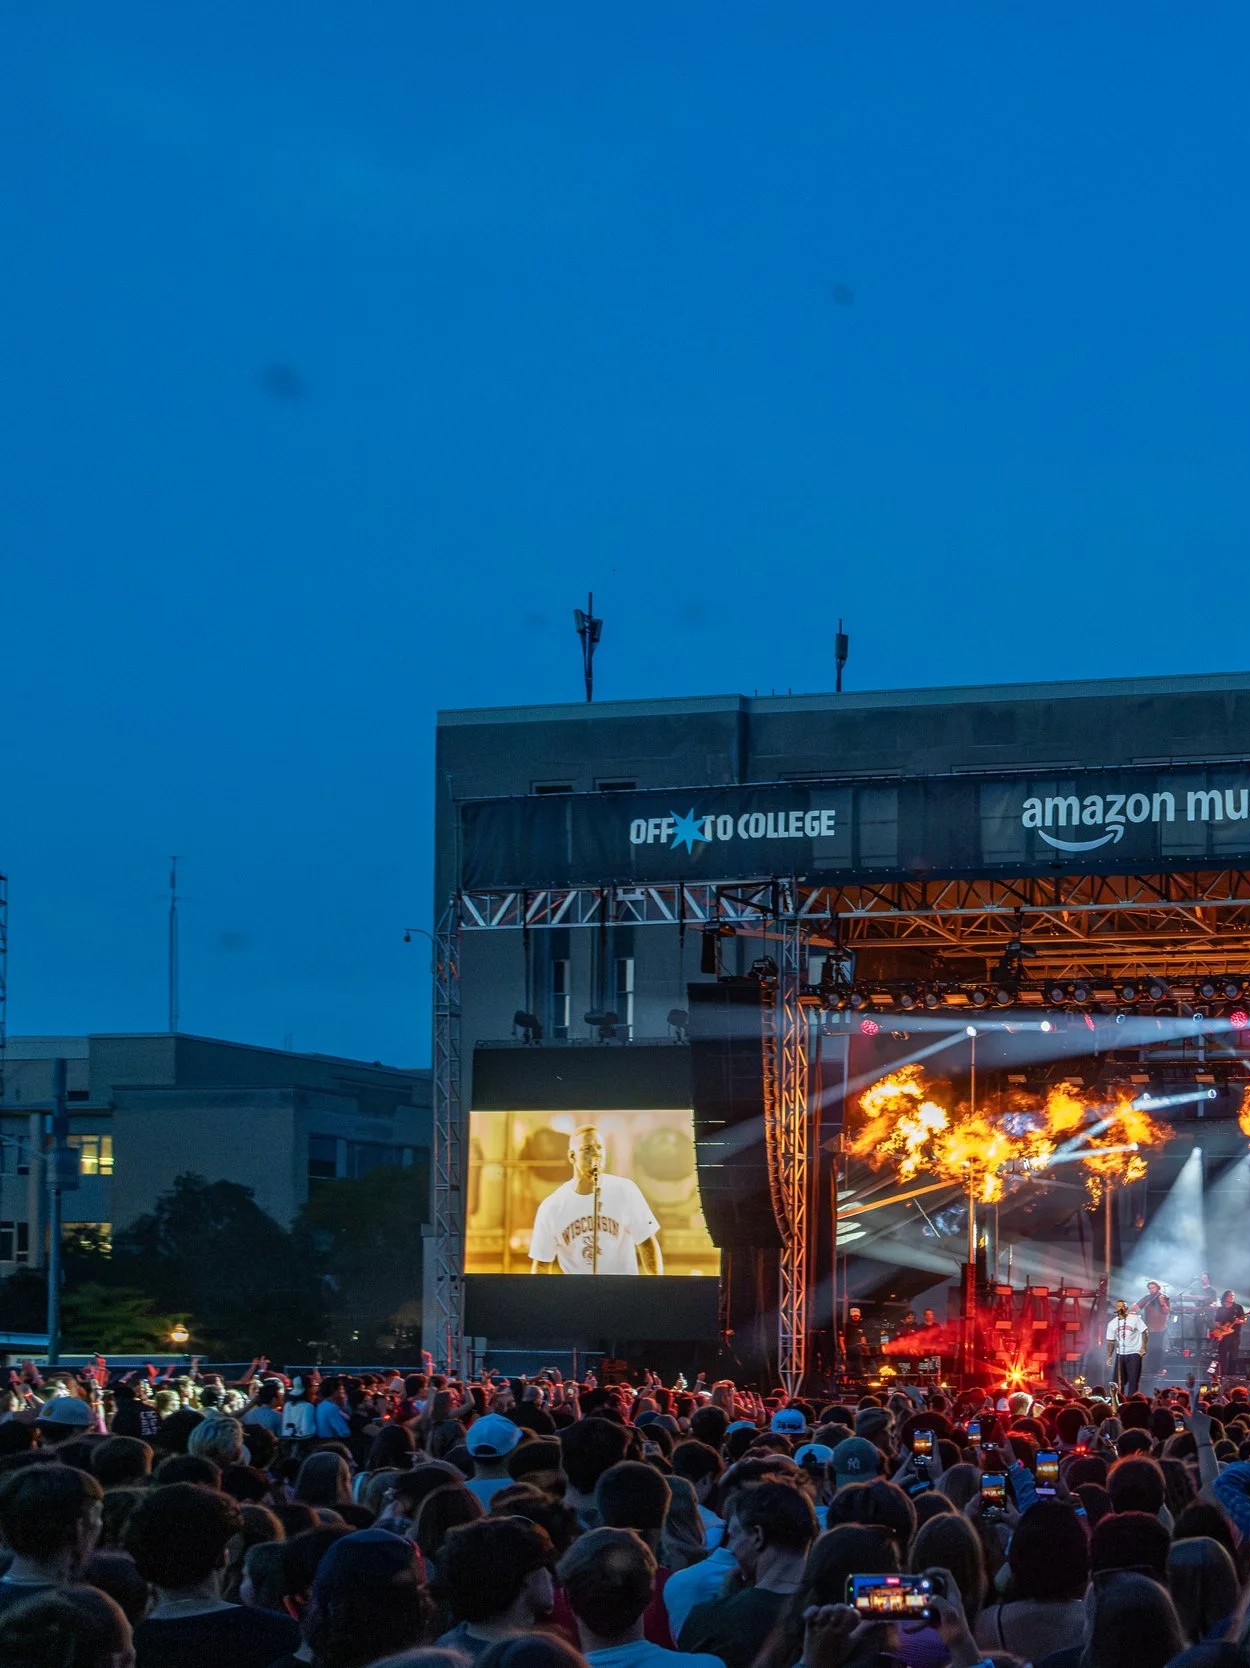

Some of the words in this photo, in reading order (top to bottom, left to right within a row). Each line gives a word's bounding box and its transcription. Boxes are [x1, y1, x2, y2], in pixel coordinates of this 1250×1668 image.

[629, 818, 674, 844] OFF
[703, 815, 734, 841] TO
[737, 810, 836, 839] COLLEGE
[1022, 793, 1175, 827] amazon
[562, 1215, 620, 1245] WISCONSIN
